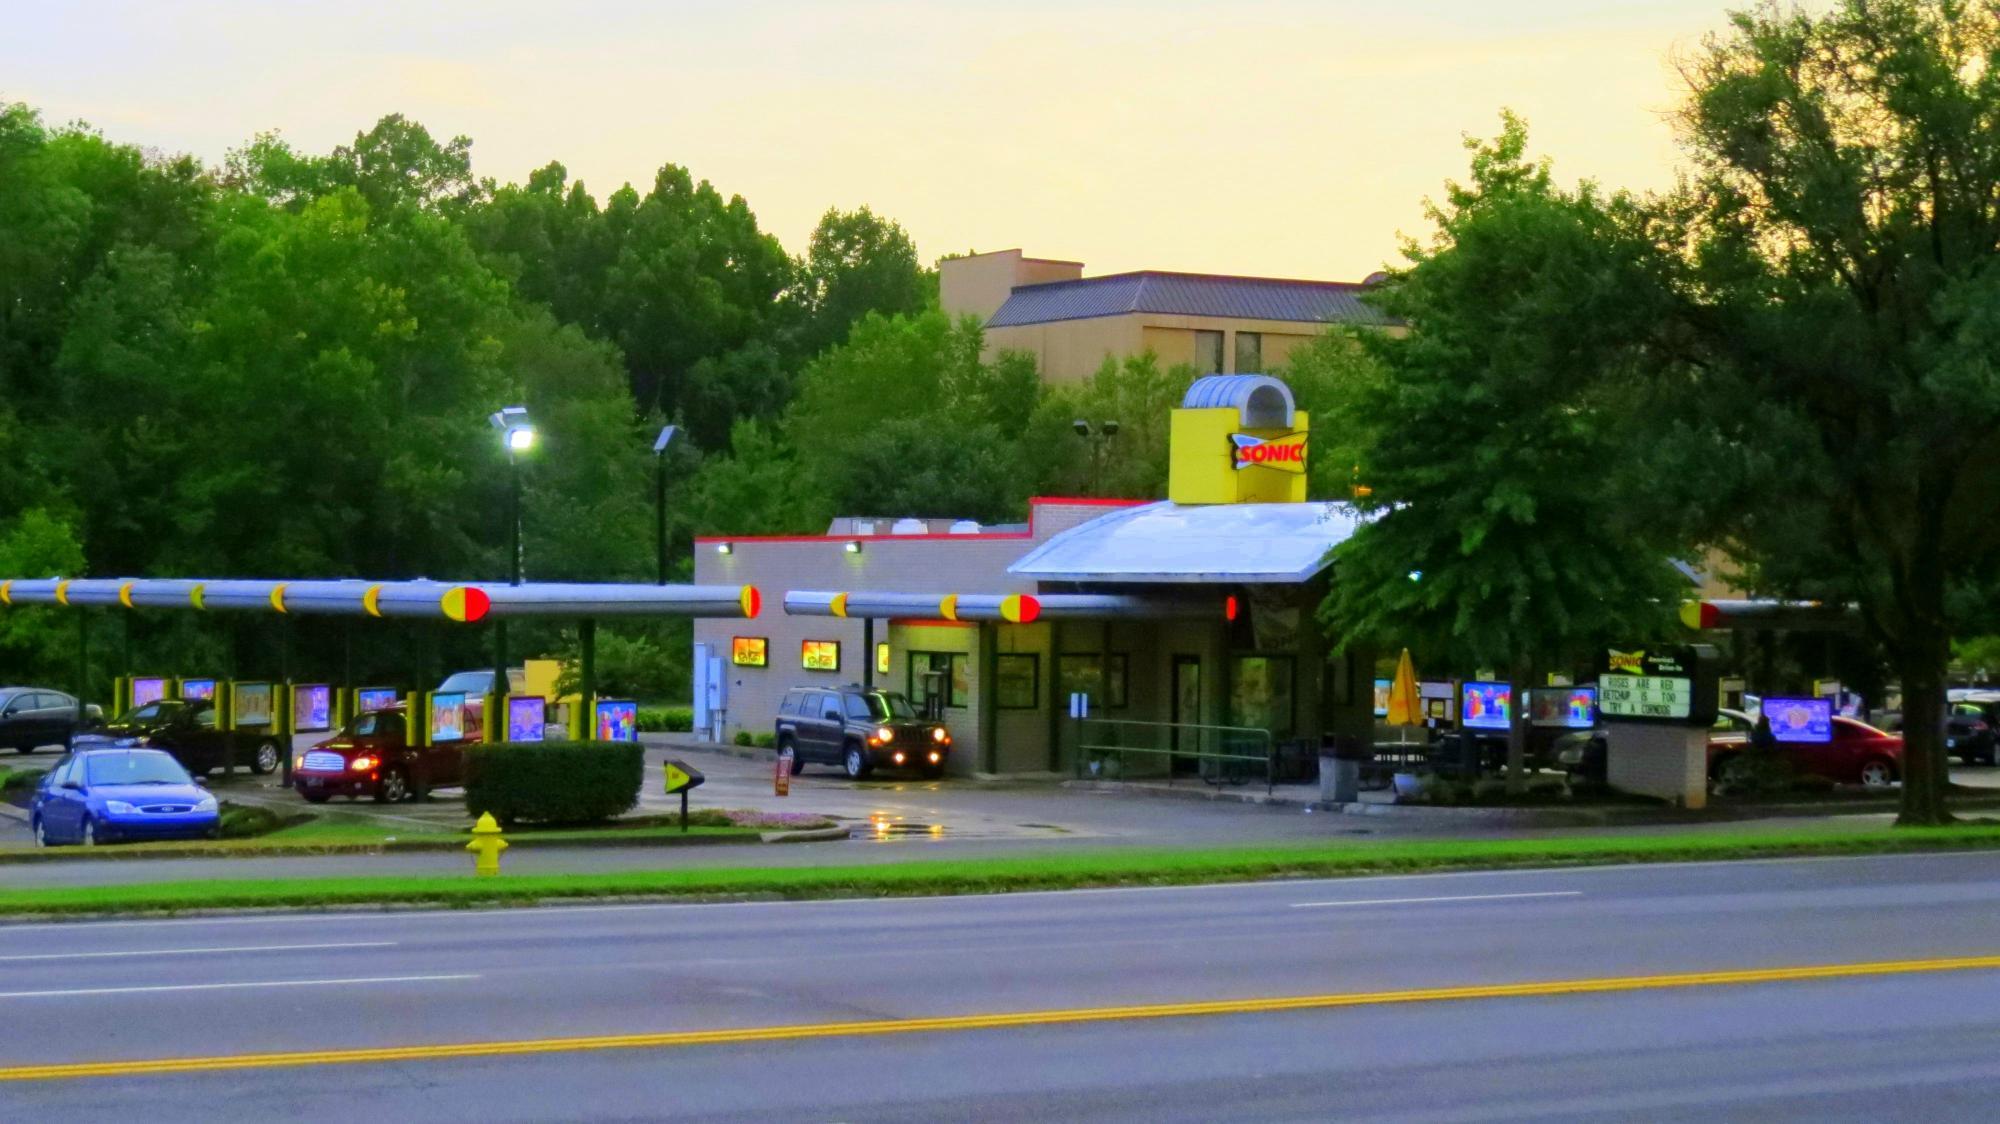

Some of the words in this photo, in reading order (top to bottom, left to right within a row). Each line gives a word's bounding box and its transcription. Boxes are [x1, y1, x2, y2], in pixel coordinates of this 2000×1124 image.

[1240, 443, 1302, 463] SONIC
[1609, 655, 1643, 667] SONIC
[1636, 679, 1650, 689] ARE
[1660, 680, 1674, 690] RED
[1603, 690, 1631, 700] KETCHUP
[1641, 691, 1648, 701] IS
[1661, 693, 1676, 703] TOO
[1609, 702, 1622, 712] TRY
[1630, 703, 1635, 713] A
